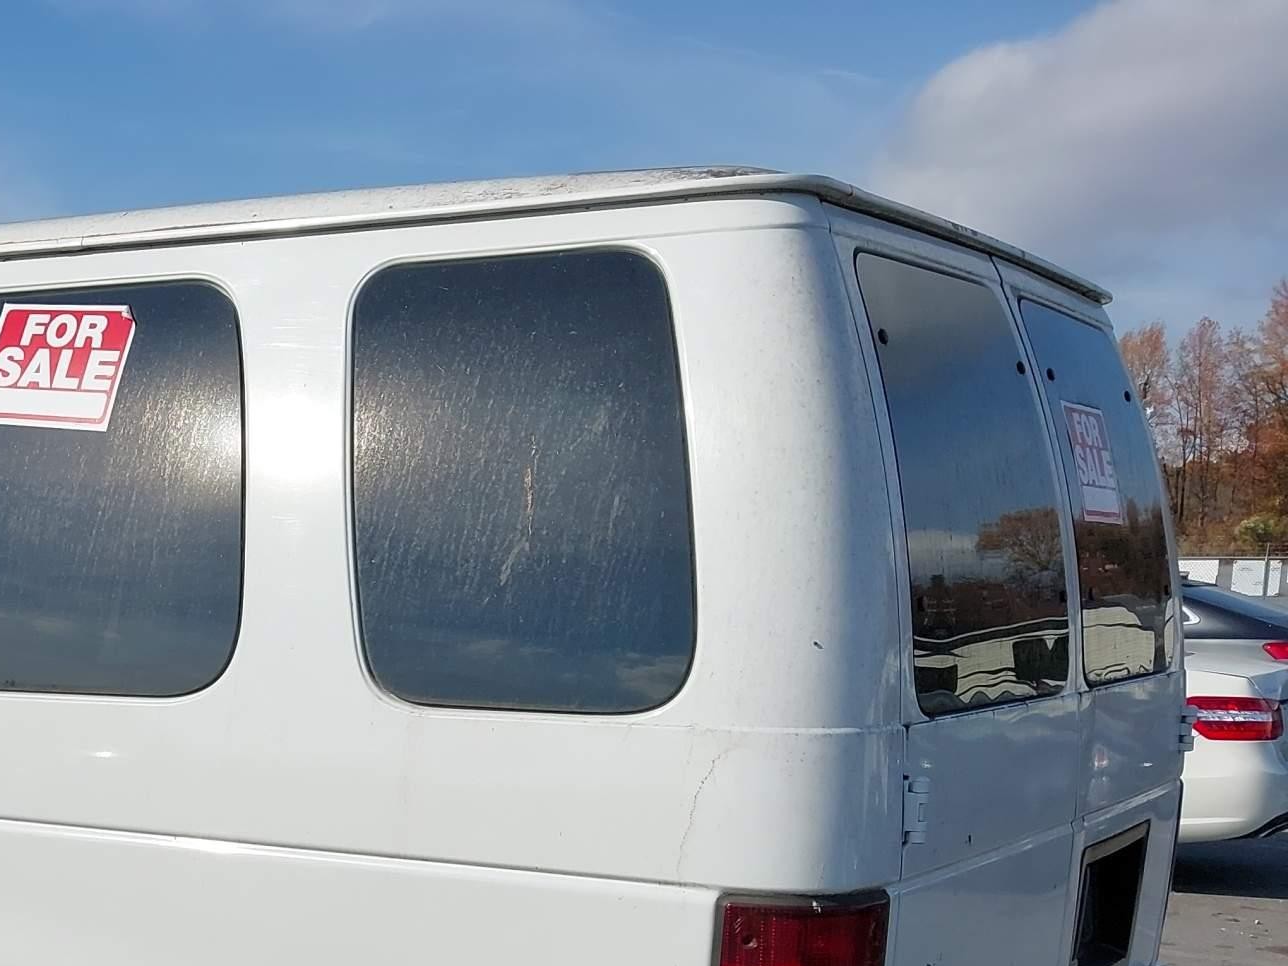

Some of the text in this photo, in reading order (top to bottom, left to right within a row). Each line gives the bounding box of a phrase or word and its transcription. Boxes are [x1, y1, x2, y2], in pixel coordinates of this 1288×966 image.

[19, 313, 108, 348] FOR
[1072, 411, 1103, 448] FOR
[1074, 443, 1116, 488] SALE
